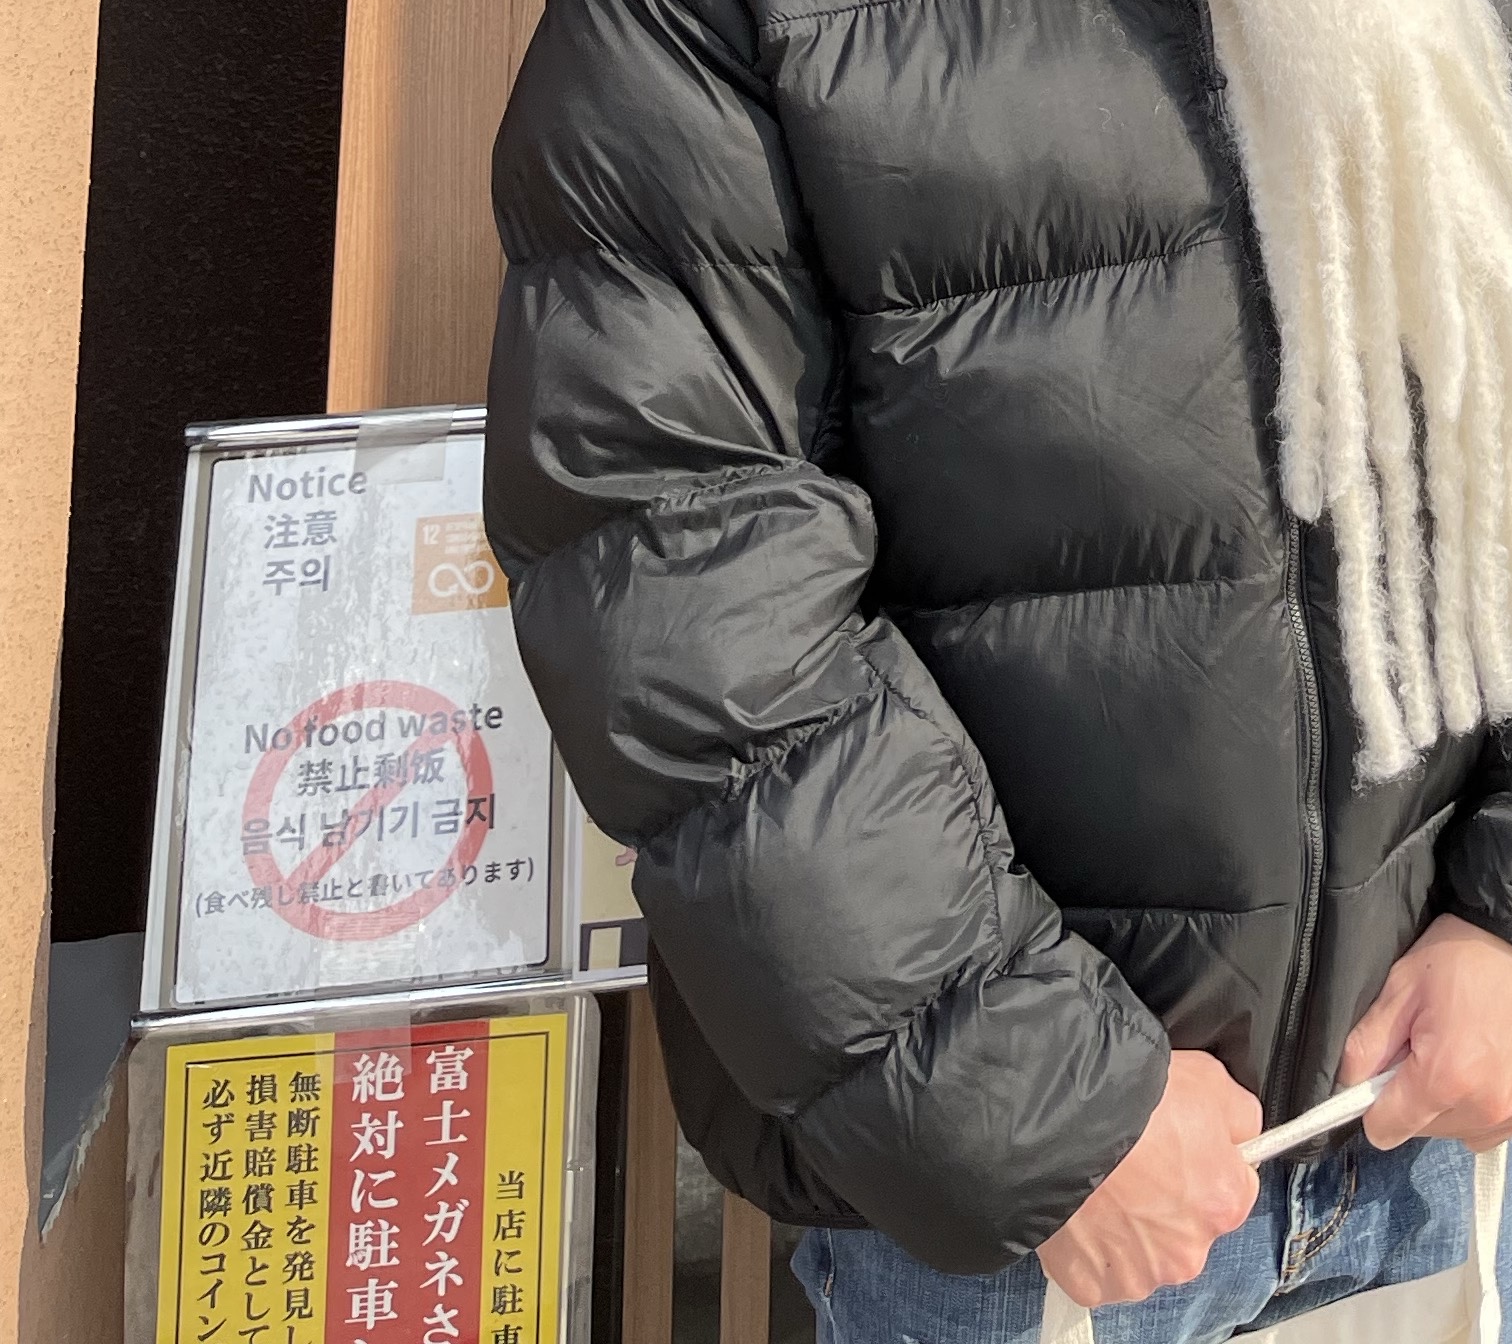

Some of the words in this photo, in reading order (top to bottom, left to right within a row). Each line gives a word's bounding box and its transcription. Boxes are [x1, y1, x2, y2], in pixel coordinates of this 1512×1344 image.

[248, 466, 368, 503] Notice
[264, 510, 338, 550] 注意
[422, 524, 441, 545] 12
[262, 555, 331, 596] 주의
[244, 723, 293, 754] No
[303, 710, 386, 749] food
[399, 703, 504, 738] waste
[241, 813, 306, 856] 음식
[320, 800, 419, 848] 남기기
[431, 793, 496, 836] 금지
[197, 1079, 235, 1342] 必ず近隣のコイン
[344, 1052, 406, 1344] 絶対に駐車
